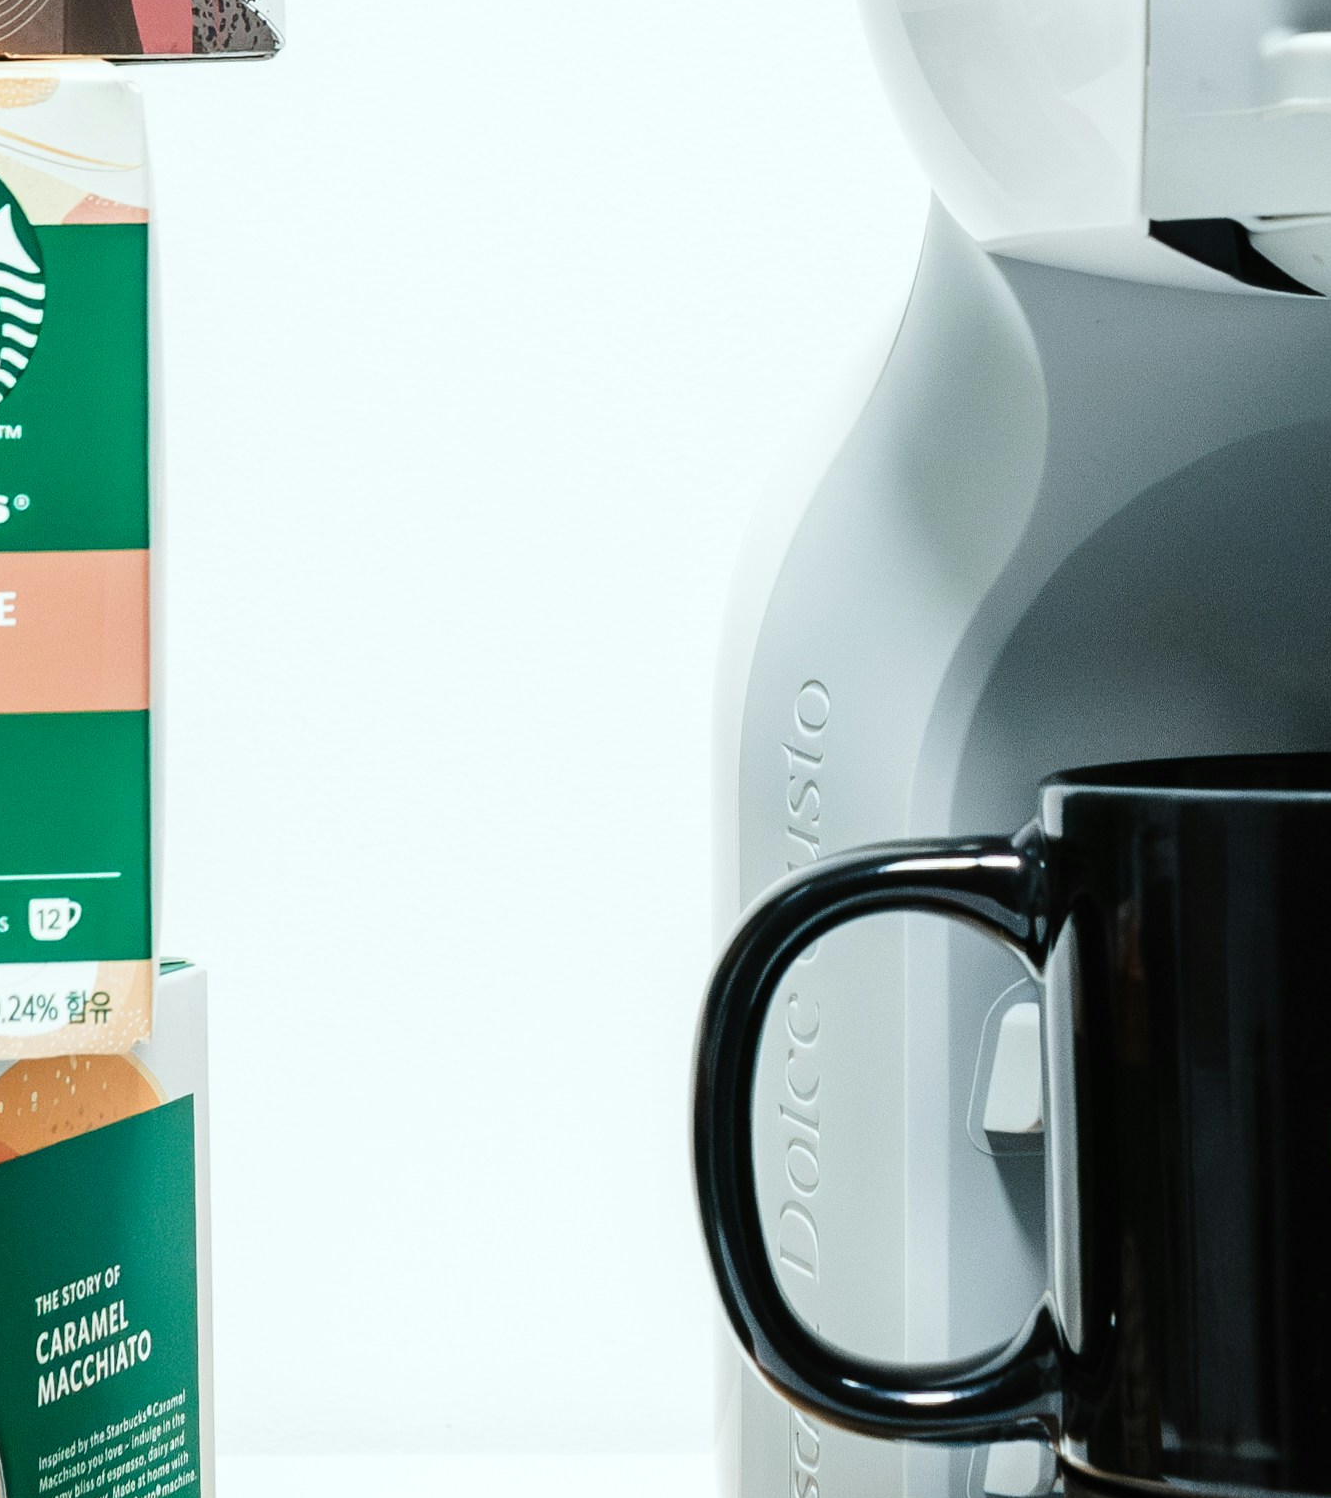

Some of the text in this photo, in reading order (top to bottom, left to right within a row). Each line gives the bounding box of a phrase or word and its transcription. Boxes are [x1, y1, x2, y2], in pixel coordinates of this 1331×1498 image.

[38, 909, 60, 930] 12
[66, 991, 112, 1024] 함유
[35, 1264, 121, 1317] THE STORY OF
[36, 1299, 129, 1365] CARAMEL
[38, 1329, 152, 1408] MACCHIATO
